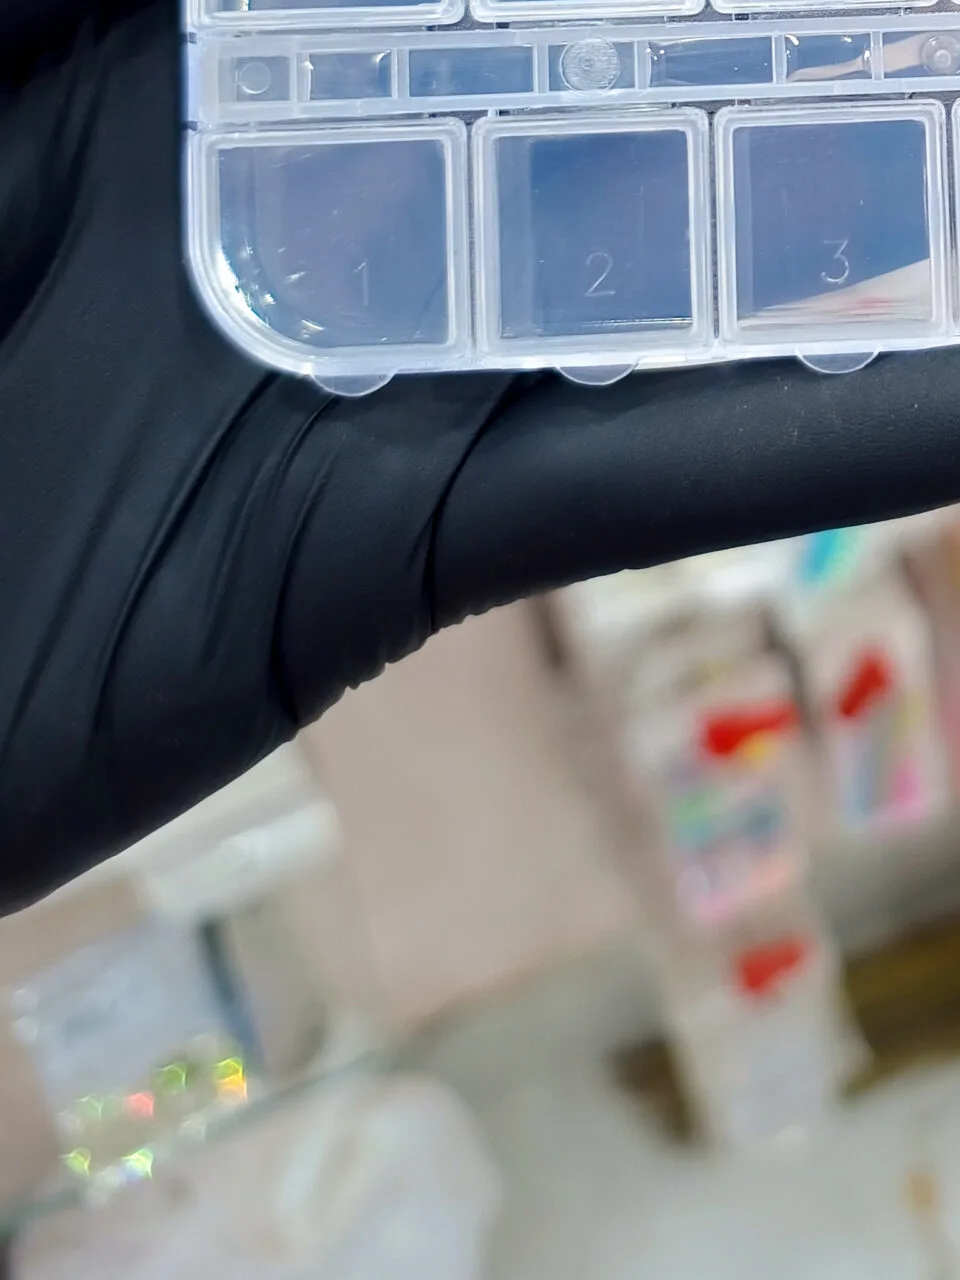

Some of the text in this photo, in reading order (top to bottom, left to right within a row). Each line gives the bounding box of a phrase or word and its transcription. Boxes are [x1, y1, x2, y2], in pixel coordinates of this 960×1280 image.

[352, 258, 370, 306] 1
[583, 250, 616, 298] 2
[820, 238, 850, 284] 3
